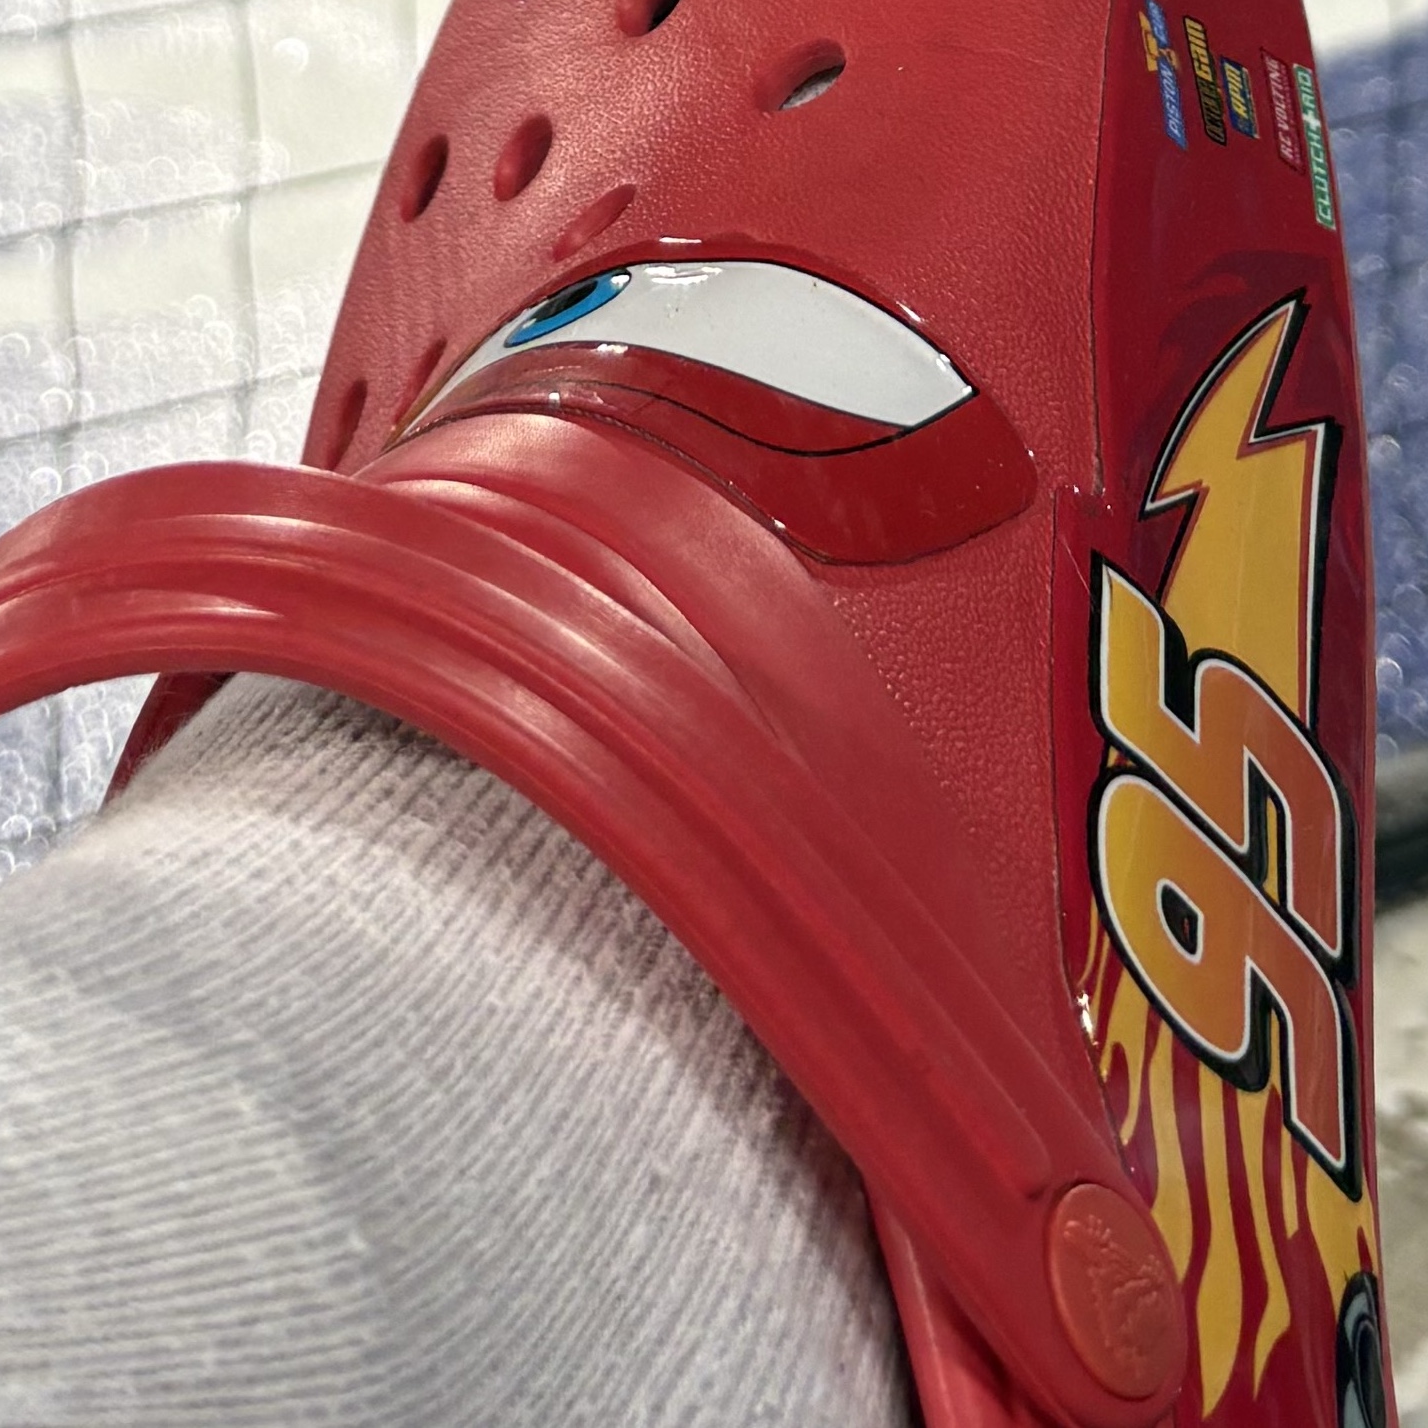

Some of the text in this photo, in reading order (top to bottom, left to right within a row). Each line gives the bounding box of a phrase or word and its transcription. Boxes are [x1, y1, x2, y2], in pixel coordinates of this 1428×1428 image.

[1160, 61, 1182, 138] PISTON
[1298, 70, 1333, 220] CLUTCH AID
[1090, 550, 1359, 1199] 95
